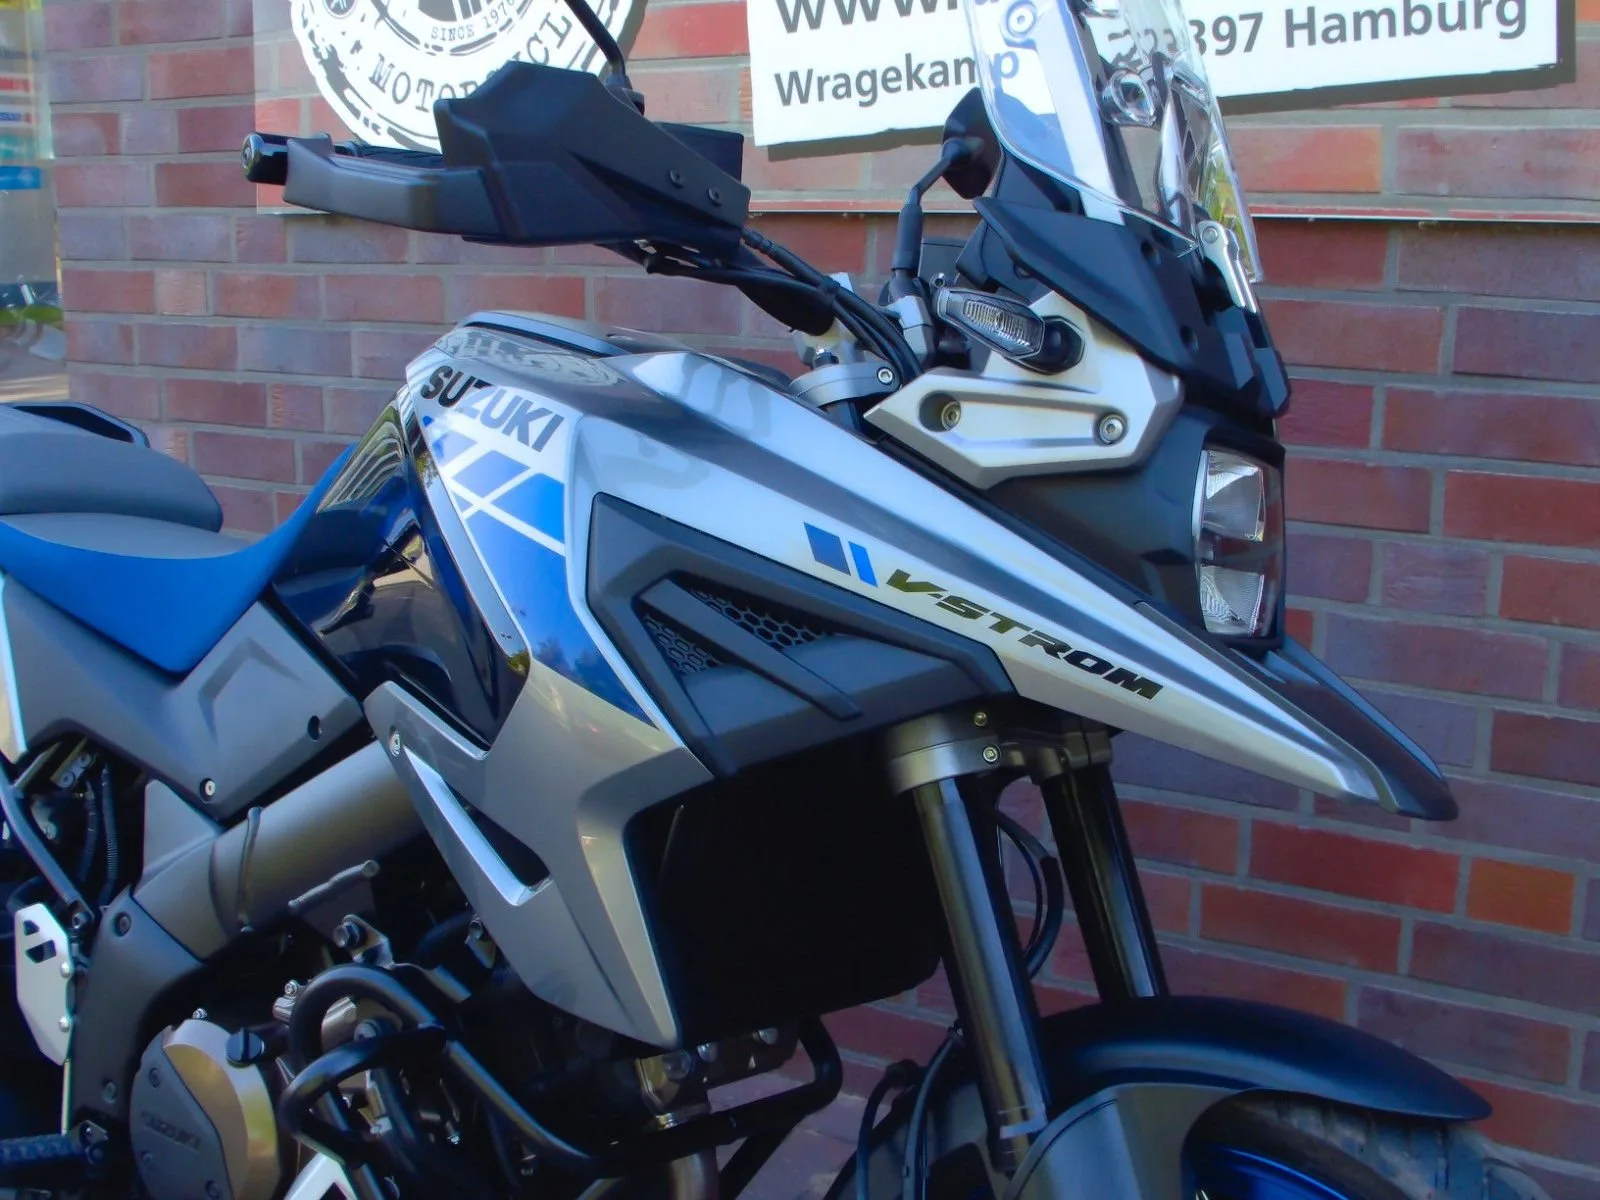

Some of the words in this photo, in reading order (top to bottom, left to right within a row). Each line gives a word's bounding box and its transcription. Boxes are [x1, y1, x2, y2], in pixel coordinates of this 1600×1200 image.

[431, 24, 475, 42] SINCE
[774, 51, 1020, 107] Wragekamp
[1285, 0, 1527, 49] Hamburg
[420, 365, 565, 452] SUZUKI
[886, 568, 1164, 700] V-STROM
